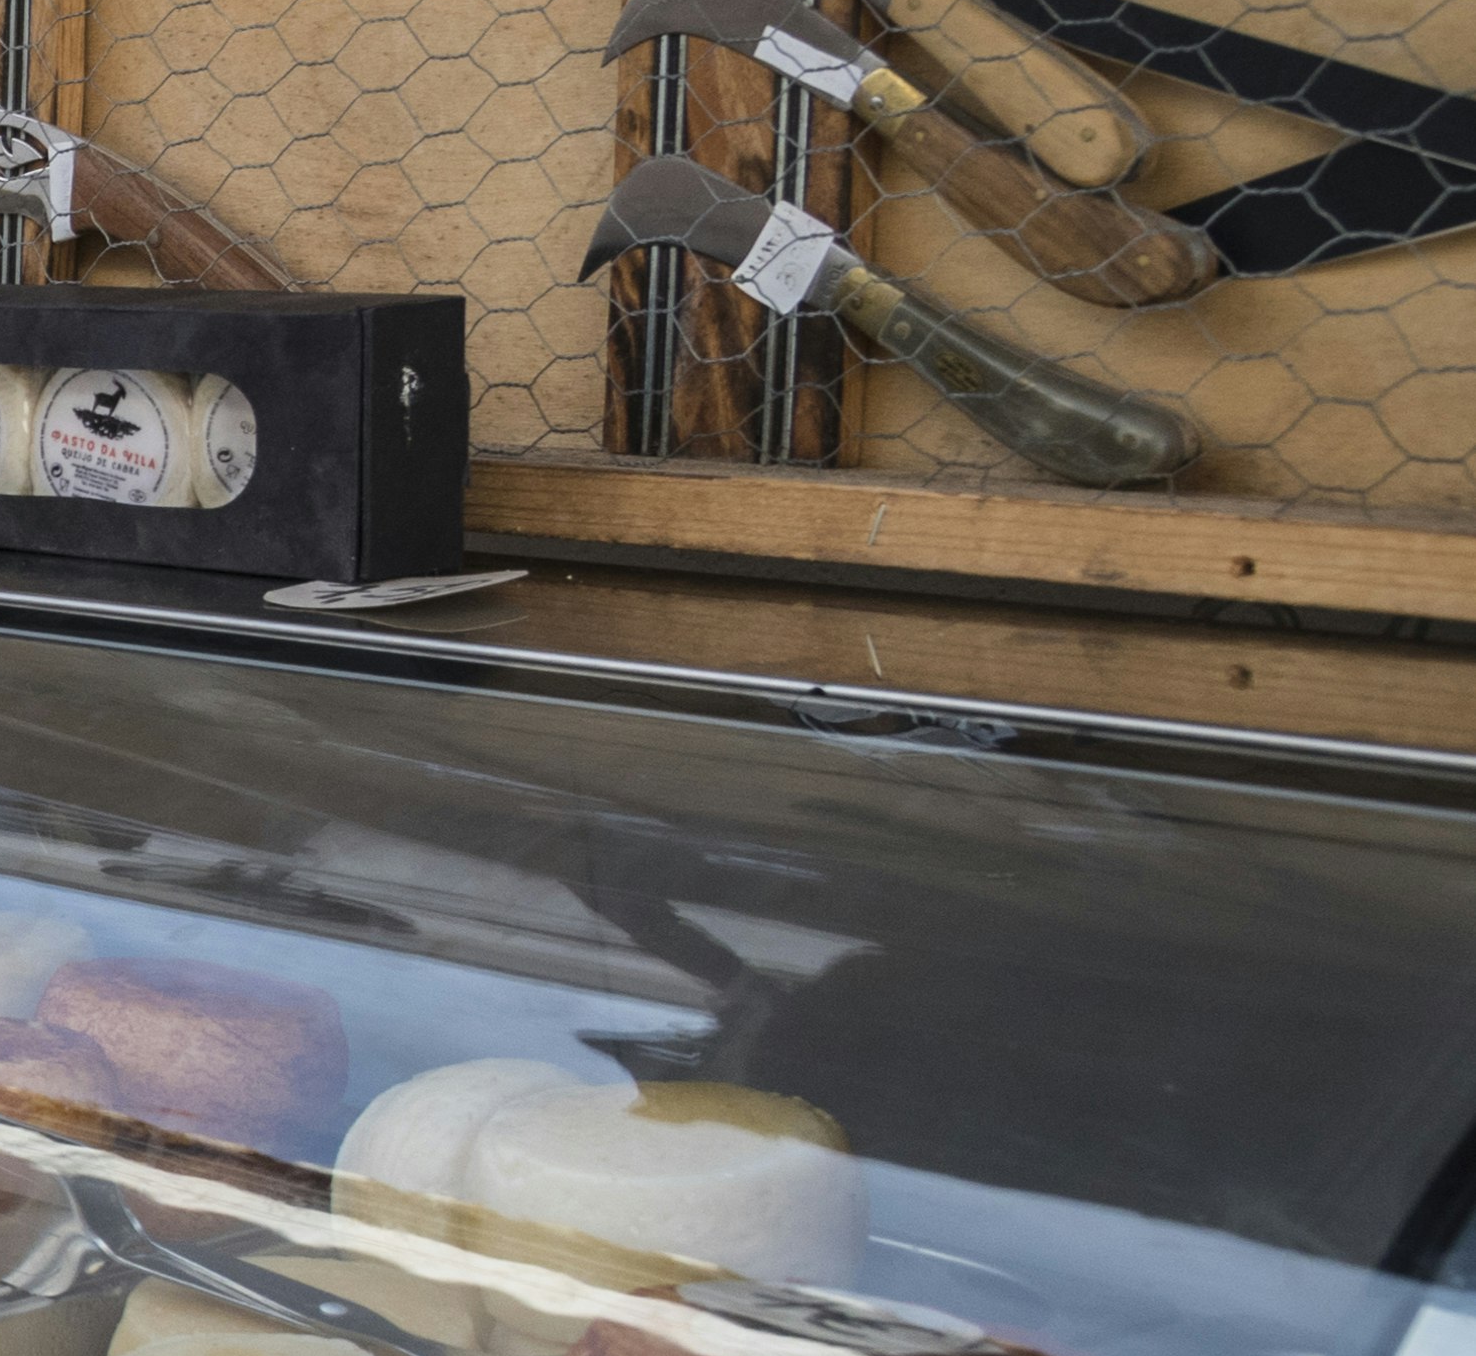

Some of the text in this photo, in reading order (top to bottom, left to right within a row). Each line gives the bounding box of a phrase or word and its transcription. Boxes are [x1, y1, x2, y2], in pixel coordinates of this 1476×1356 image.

[51, 430, 156, 470] PASTO DA VILA
[61, 448, 140, 476] QUEIJO DE CABRA
